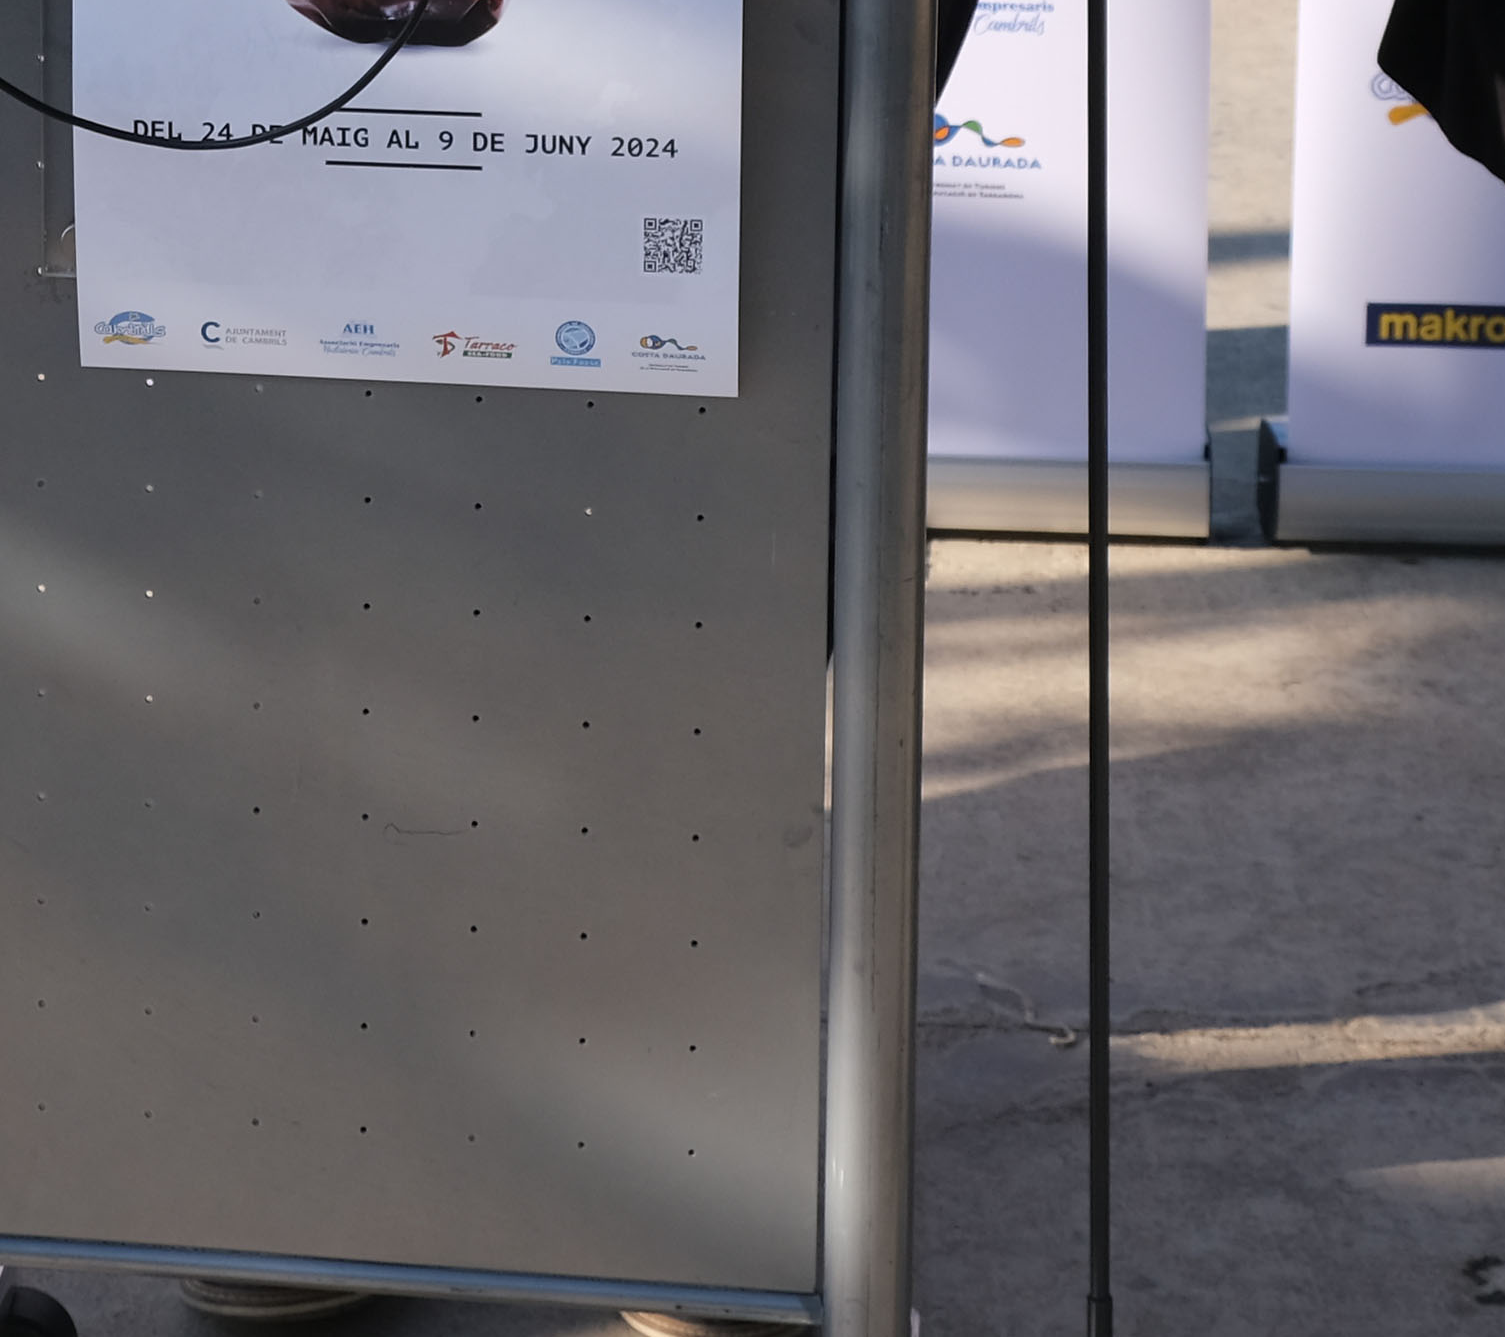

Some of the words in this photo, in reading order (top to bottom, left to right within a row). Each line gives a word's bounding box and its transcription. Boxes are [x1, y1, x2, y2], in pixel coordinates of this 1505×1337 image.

[978, 0, 1055, 14] mpresaris
[133, 120, 182, 141] DEL
[202, 122, 234, 141] 24
[302, 126, 369, 147] MAIG
[387, 129, 419, 150] AL
[439, 130, 454, 151] 9
[472, 132, 505, 152] DE
[525, 134, 592, 156] JUNY
[610, 137, 679, 158] 2024
[952, 156, 1041, 169] DAURADA
[225, 327, 287, 337] AJUNTAMENT
[225, 336, 237, 344] DE
[242, 337, 287, 346] CAMBRILS
[464, 336, 518, 351] Tarraco
